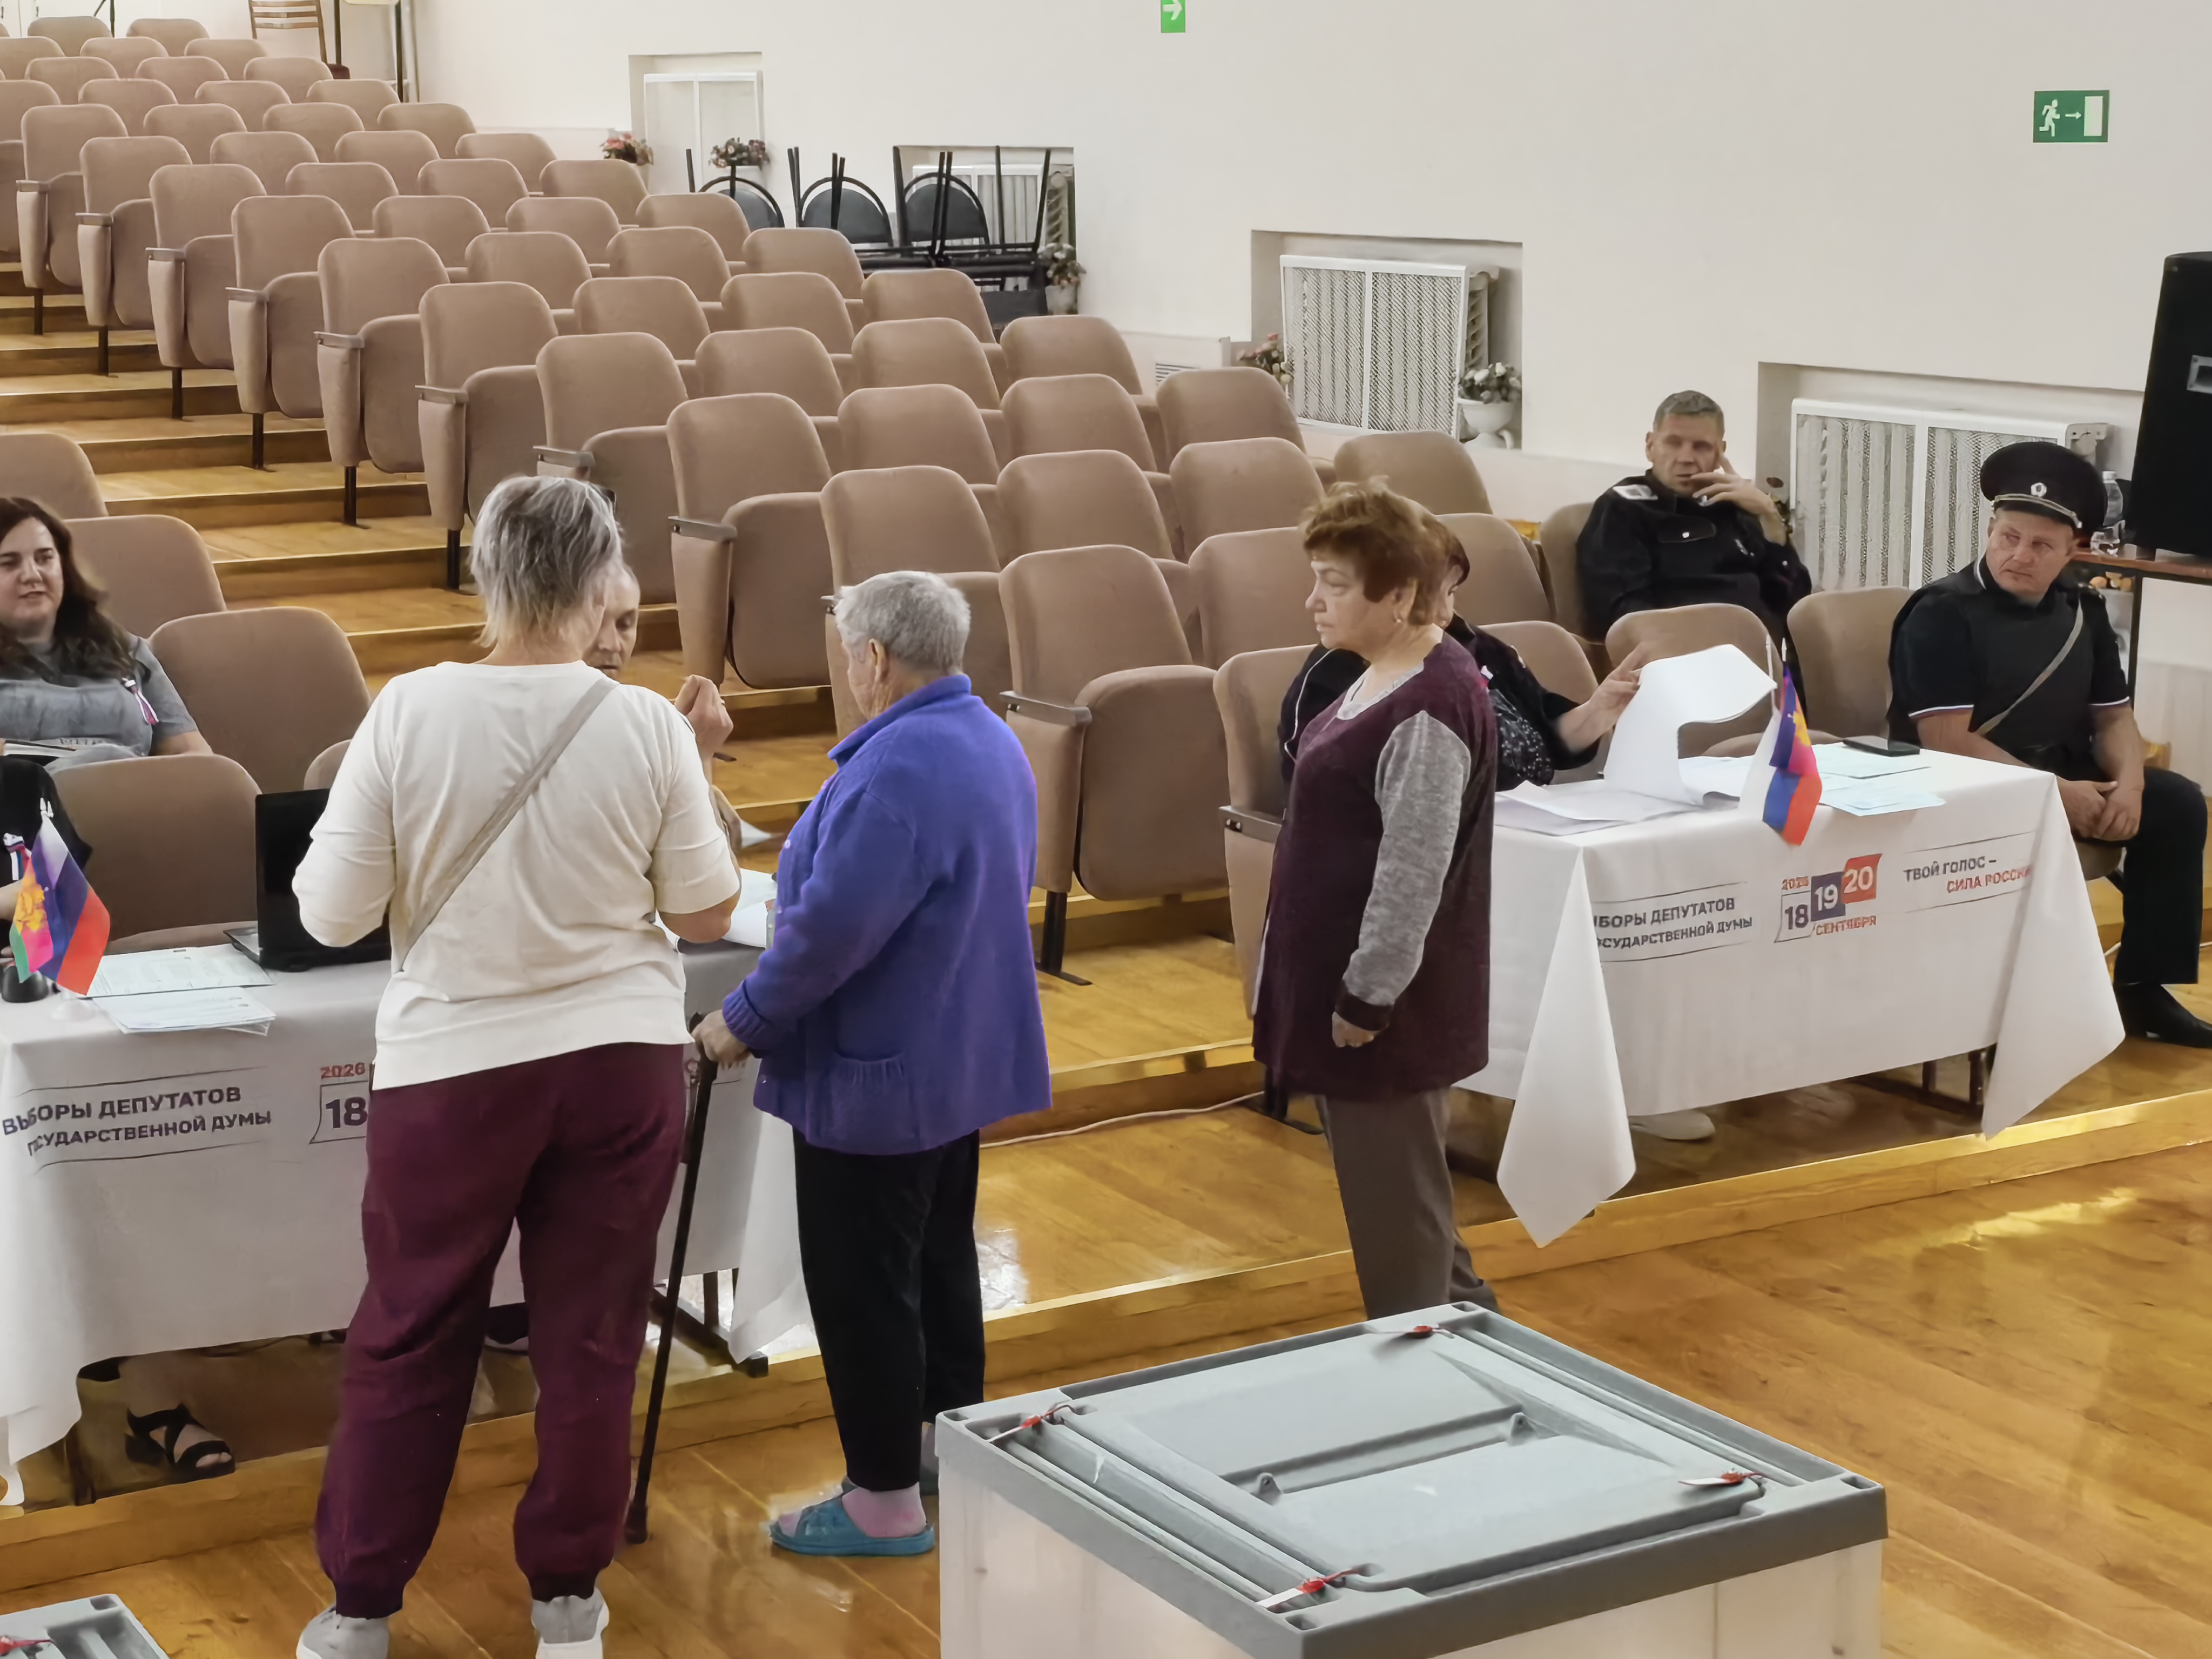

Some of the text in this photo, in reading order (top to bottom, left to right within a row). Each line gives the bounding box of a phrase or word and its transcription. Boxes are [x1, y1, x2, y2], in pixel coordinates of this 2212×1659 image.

[1903, 861, 1939, 882] ТВОЙ
[1943, 856, 1985, 874] ГОЛОС
[1946, 875, 1982, 893] СИЛА
[1594, 898, 1735, 928] БОРЫ ДЕПУТАТОВ
[1784, 866, 1873, 930] 18 19 20
[1597, 917, 1752, 949] СУДАРСТВЕННОЙ ДУМЫ
[320, 1062, 366, 1080] 2026
[98, 1087, 241, 1120] ДЕПУТАТОВ
[326, 1097, 368, 1128] 18
[28, 1111, 271, 1156] ГСУДАРСТВЕННОЙ ДУМЫ
